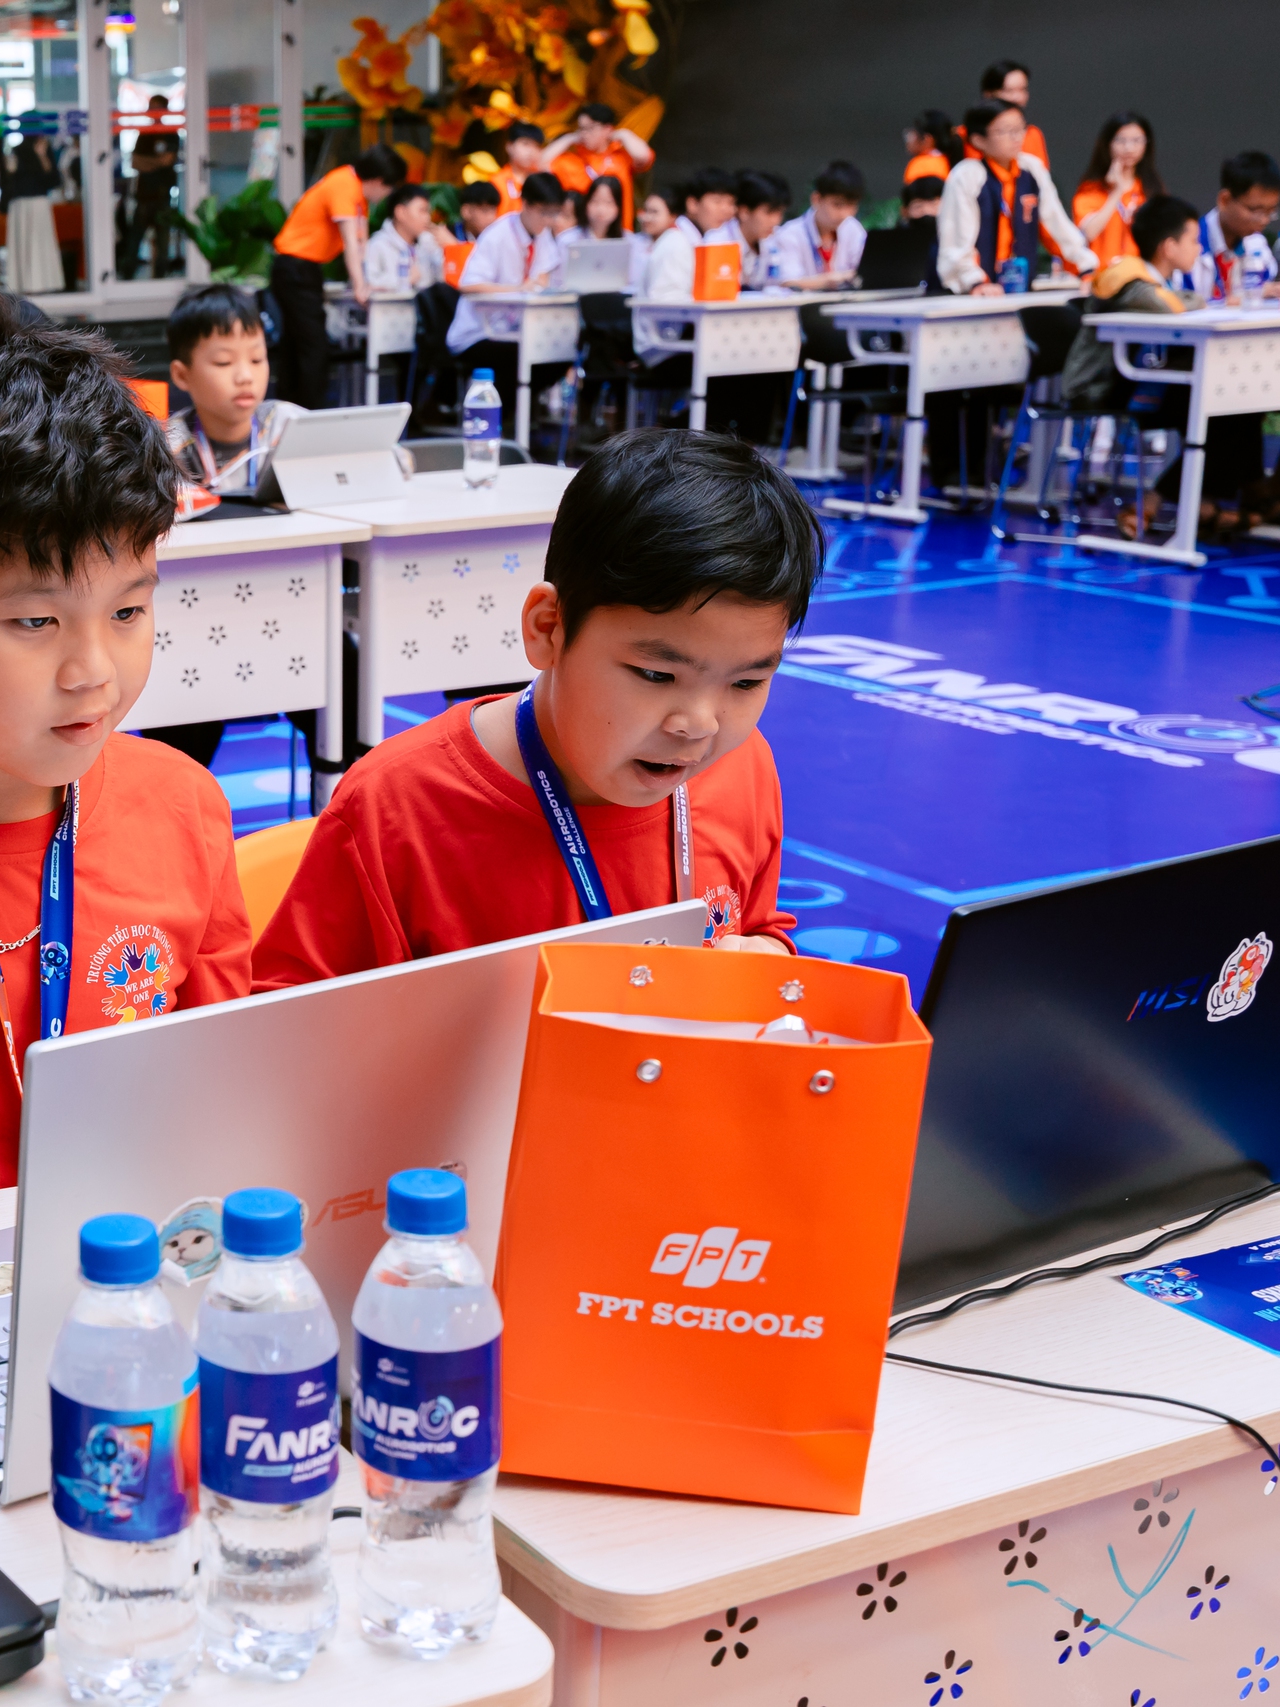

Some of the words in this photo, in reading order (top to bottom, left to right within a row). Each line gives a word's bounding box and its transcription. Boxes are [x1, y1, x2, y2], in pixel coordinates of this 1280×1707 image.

[563, 807, 586, 855] CHALLENGE
[131, 924, 151, 939] HỌC
[124, 982, 138, 994] WE
[139, 976, 154, 990] ARE
[133, 990, 149, 1004] ONE
[311, 1188, 386, 1227] ASU
[650, 1226, 772, 1288] FPT
[577, 1292, 645, 1322] FPT
[651, 1302, 824, 1339] SCHOOLS
